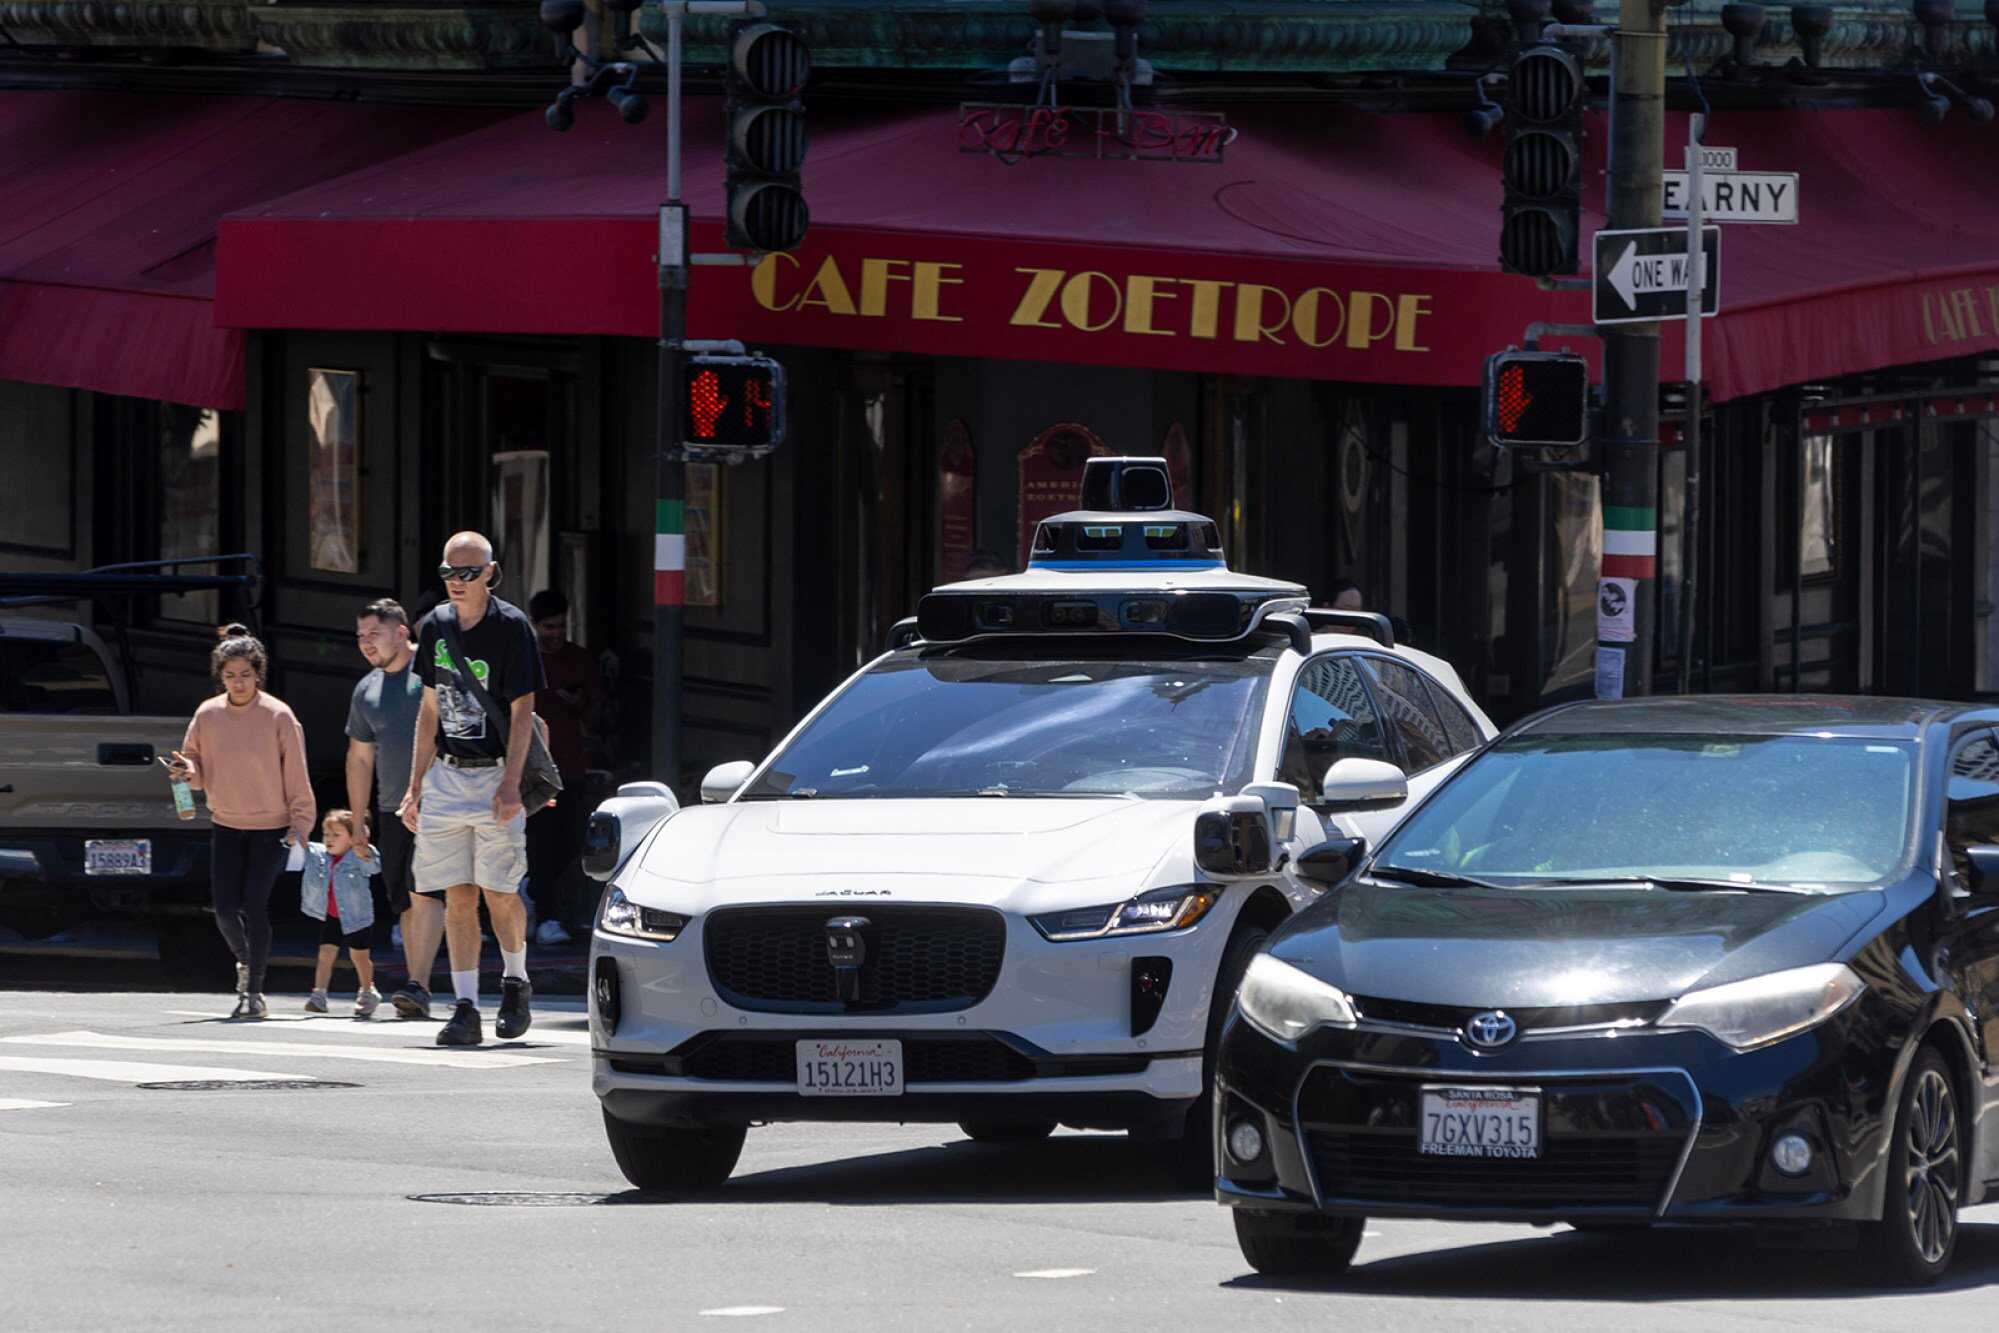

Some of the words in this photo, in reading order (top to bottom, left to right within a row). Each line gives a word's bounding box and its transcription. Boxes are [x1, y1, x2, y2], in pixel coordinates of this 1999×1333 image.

[1664, 181, 1787, 212] ERNY
[1632, 260, 1664, 289] ONE
[751, 251, 963, 322] CAFE
[1009, 267, 1433, 352] ZOETROPE
[819, 1043, 883, 1061] California
[804, 1060, 896, 1088] 15121H3
[1427, 1112, 1533, 1146] 7GXV315
[1421, 1142, 1484, 1157] FREEMAN
[1486, 1145, 1538, 1159] TOYOTA
